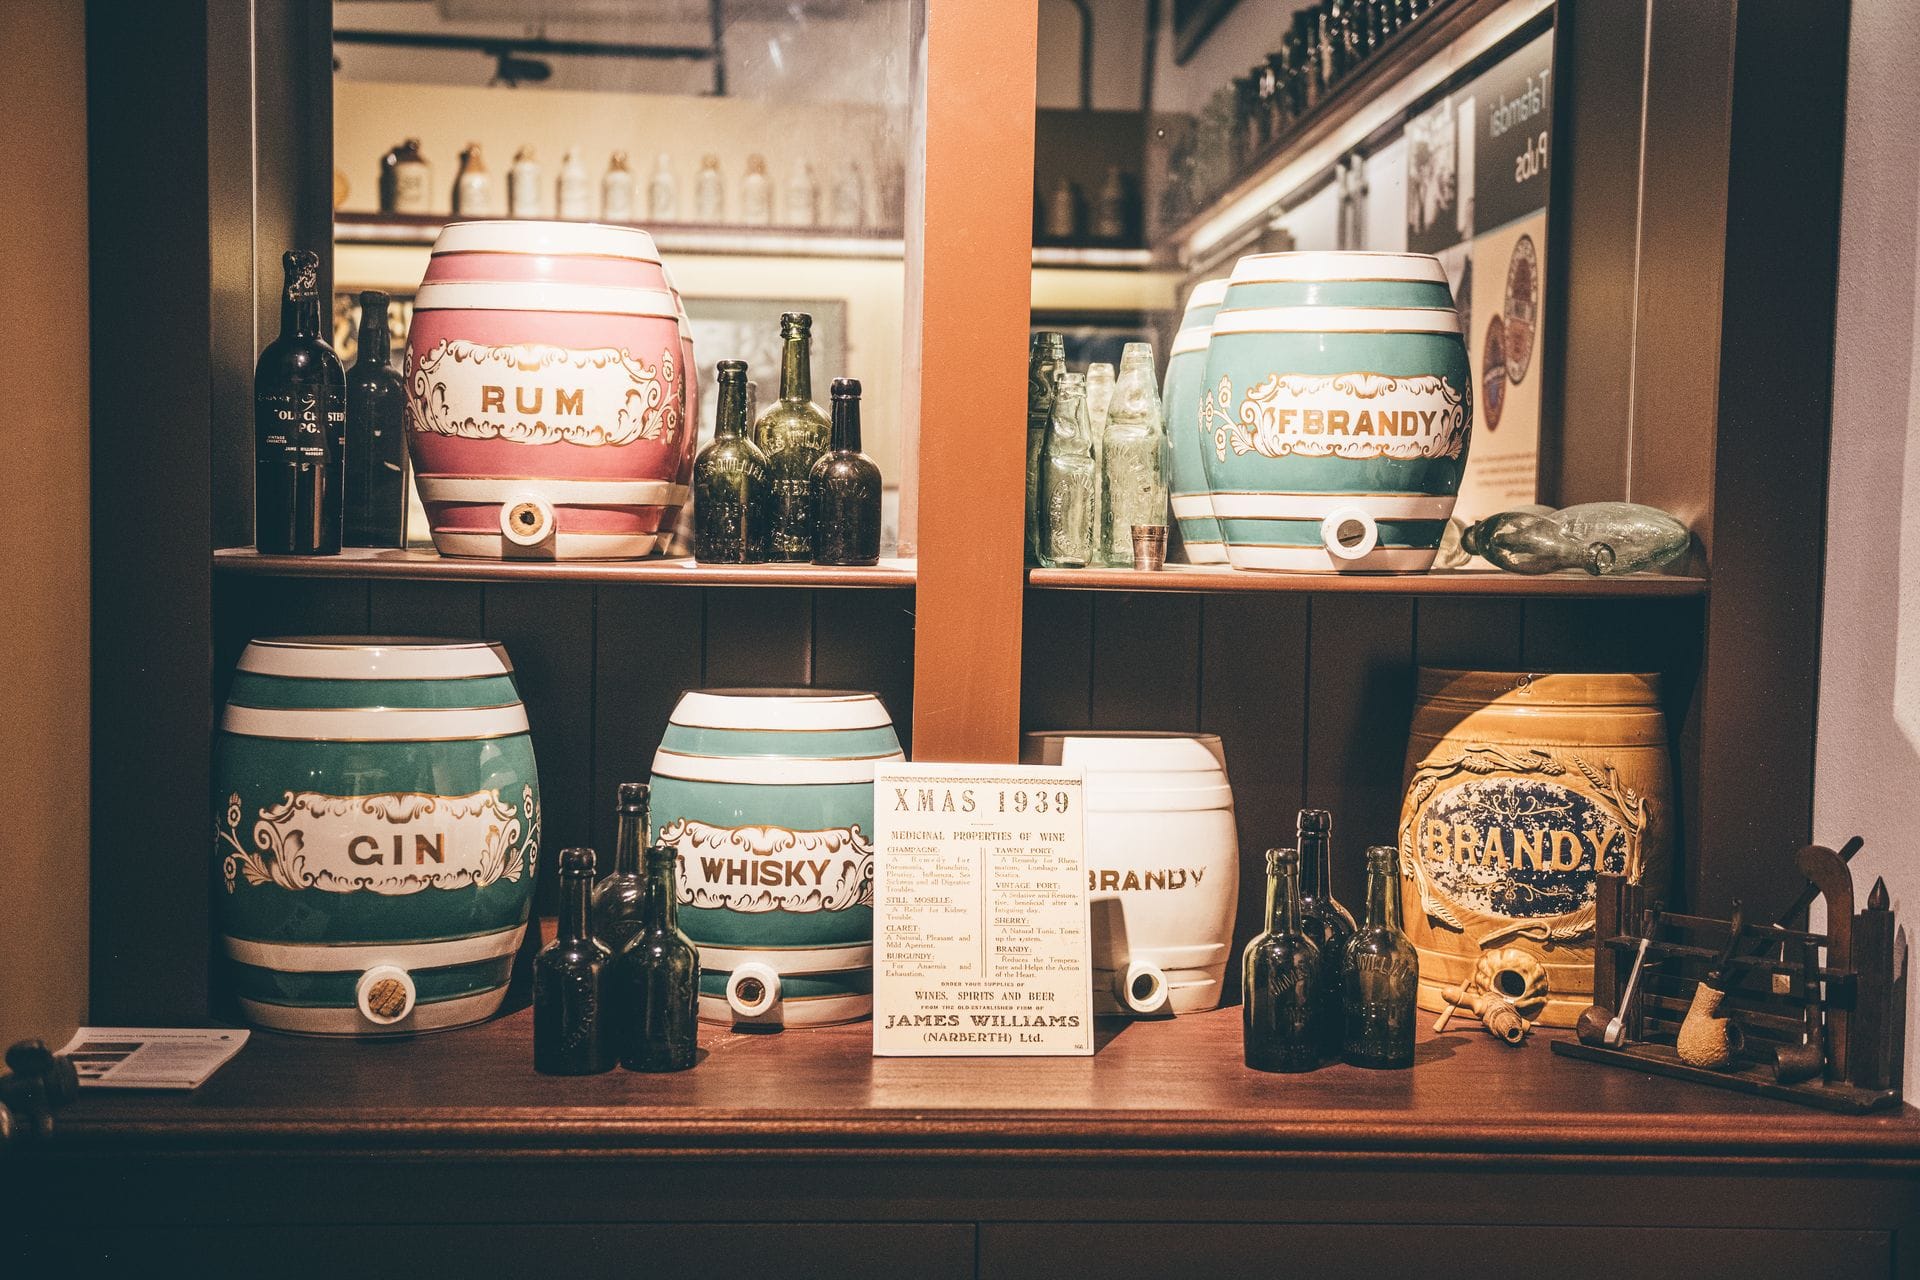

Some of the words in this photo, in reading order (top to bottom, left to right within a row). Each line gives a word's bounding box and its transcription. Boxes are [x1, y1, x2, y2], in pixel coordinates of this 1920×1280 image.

[481, 385, 584, 416] RUM
[1278, 409, 1437, 437] F.BRANDY
[894, 788, 976, 812] XMAS
[998, 790, 1069, 814] 1939
[891, 831, 945, 840] MEDICINAL
[953, 831, 1012, 841] PROPERTIES
[1019, 832, 1032, 841] OF
[1039, 832, 1065, 842] WINE
[348, 832, 445, 865] GIN
[1426, 819, 1619, 872] BRANDY
[700, 856, 831, 886] WHISKY
[1028, 864, 1058, 872] Lumbago
[944, 906, 967, 914] Kidney
[958, 934, 971, 942] and
[1024, 964, 1044, 972] Helps
[957, 991, 995, 1001] SPIRITS
[1001, 991, 1022, 1001] AND
[1028, 991, 1055, 1002] BEER
[885, 1014, 960, 1029] JAMES
[970, 1014, 1080, 1028] WILLIAMS
[922, 1032, 1013, 1044] (NARBERTH)
[1019, 1033, 1044, 1043] Ltd.
